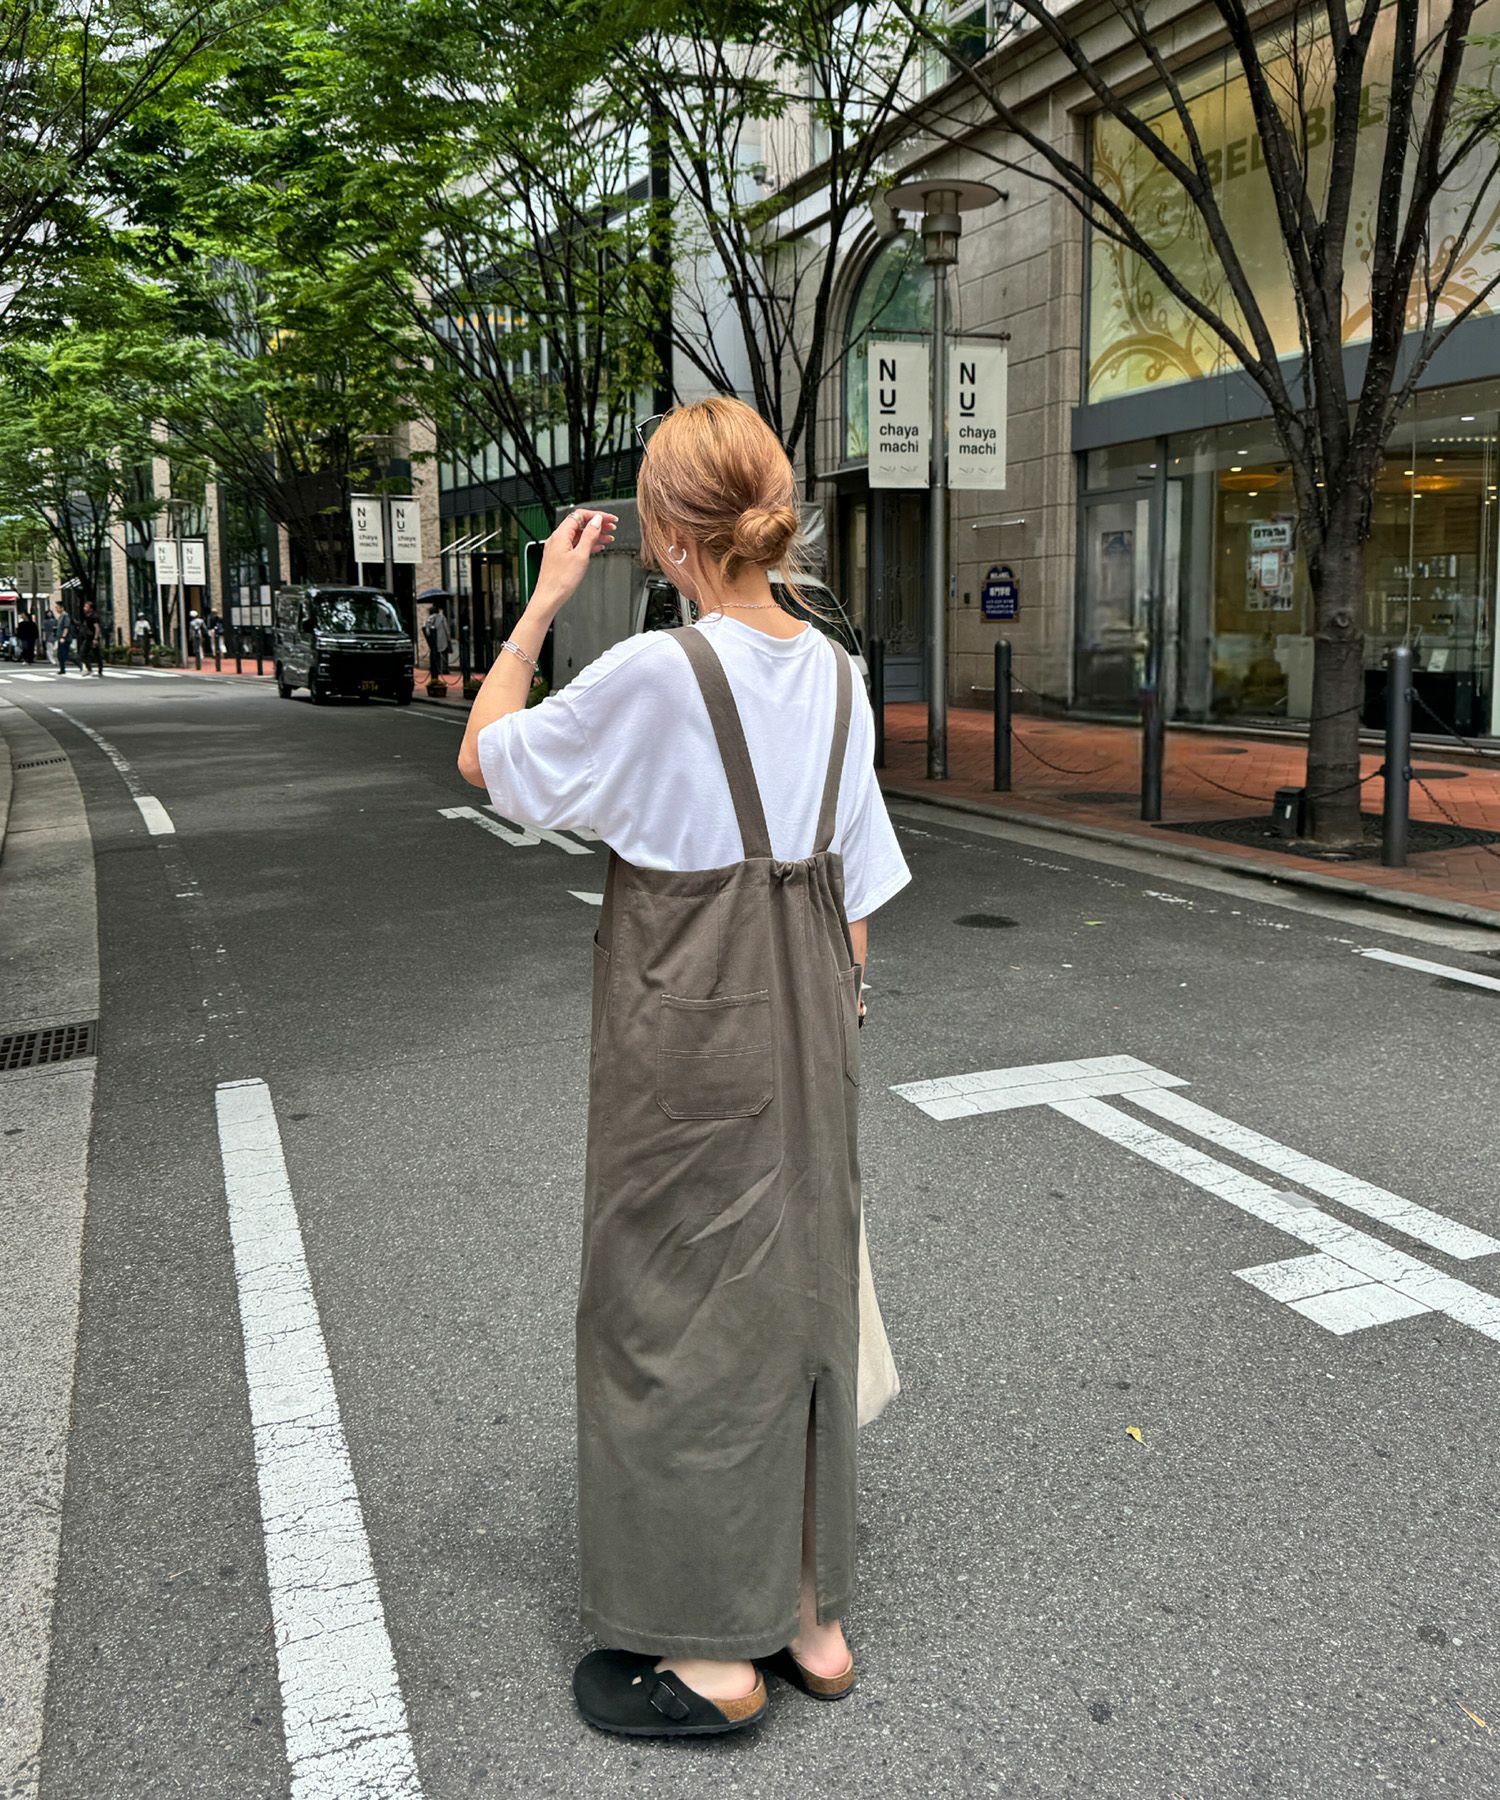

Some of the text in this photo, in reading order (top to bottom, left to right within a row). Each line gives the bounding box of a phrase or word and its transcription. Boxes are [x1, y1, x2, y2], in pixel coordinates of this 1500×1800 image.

[879, 423, 919, 441] chaya
[958, 425, 997, 442] chaya
[879, 440, 919, 453] machi
[958, 443, 997, 455] machi
